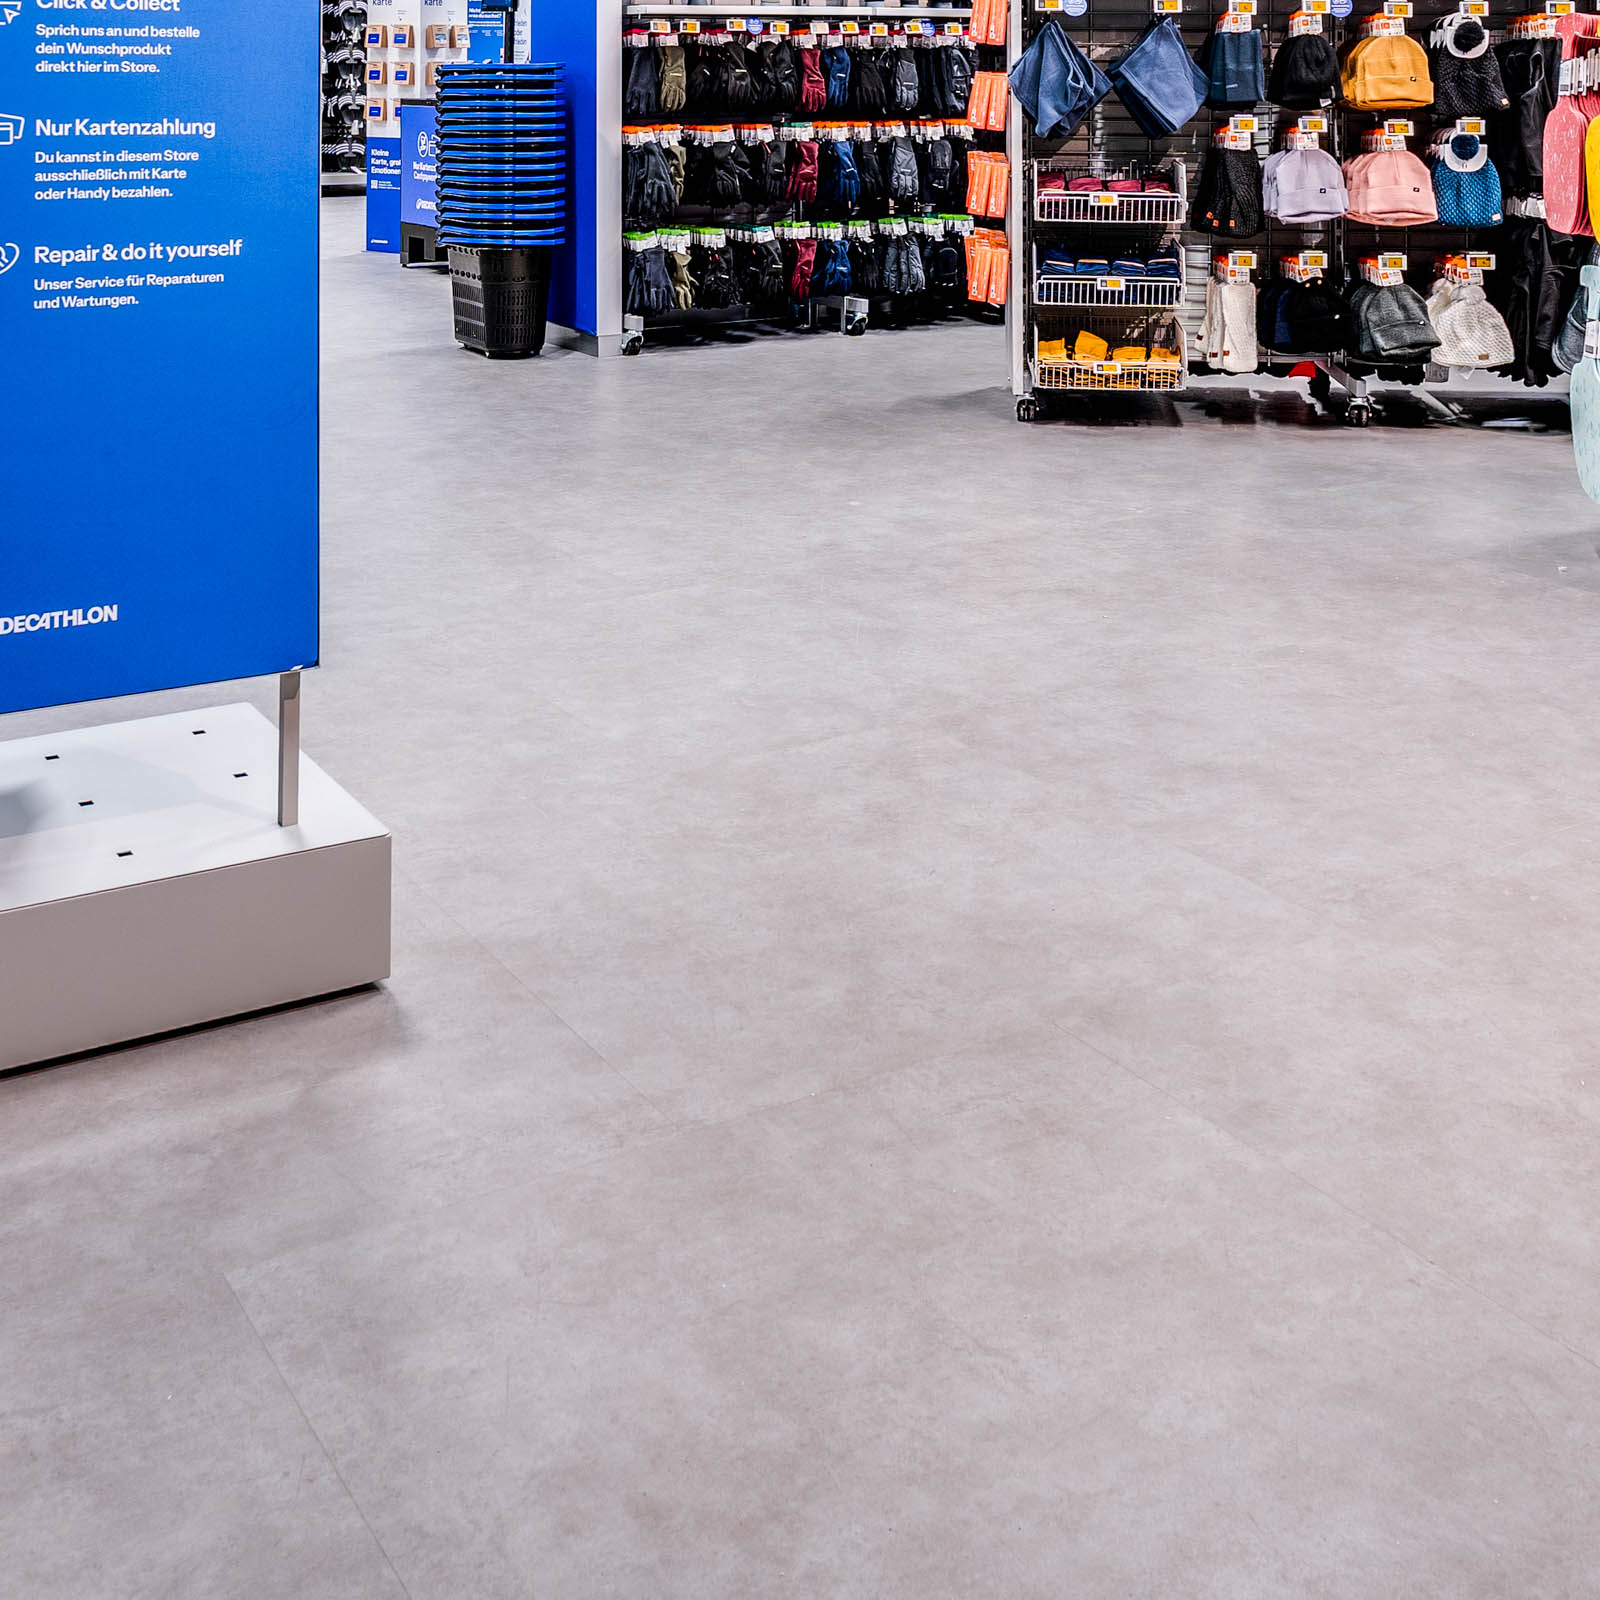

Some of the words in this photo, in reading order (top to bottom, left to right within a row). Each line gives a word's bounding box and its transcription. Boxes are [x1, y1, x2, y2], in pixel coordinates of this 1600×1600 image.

[35, 23, 80, 39] Sprich
[80, 27, 105, 37] uns
[105, 27, 123, 37] an
[123, 25, 149, 37] und
[150, 25, 201, 38] bestelle
[35, 42, 65, 54] dein
[66, 42, 172, 57] Wunschprodukt
[35, 60, 76, 73] direkt
[76, 60, 103, 73] hier
[103, 60, 120, 73] im
[120, 60, 161, 73] Store.
[35, 118, 73, 137] Nur
[75, 118, 216, 139] Kartenzahlung
[35, 151, 55, 164] Du
[55, 151, 102, 163] kannst
[102, 153, 115, 162] in
[115, 150, 163, 162] diesem
[163, 149, 200, 162] Store
[34, 168, 128, 182] ausschließlich
[128, 167, 151, 180] mit
[151, 167, 187, 180] Karte
[34, 187, 66, 201] oder
[67, 186, 111, 201] Handy
[111, 185, 173, 198] bezahlen.
[34, 244, 100, 267] Repair
[101, 243, 118, 261] &
[120, 242, 147, 261] do
[149, 242, 164, 259] it
[165, 238, 243, 263] yourself
[34, 278, 74, 291] Unser
[74, 276, 125, 289] Service
[125, 274, 145, 287] für
[146, 273, 225, 288] Reparaturen
[33, 296, 60, 310] und
[61, 295, 139, 309] Wartungen.
